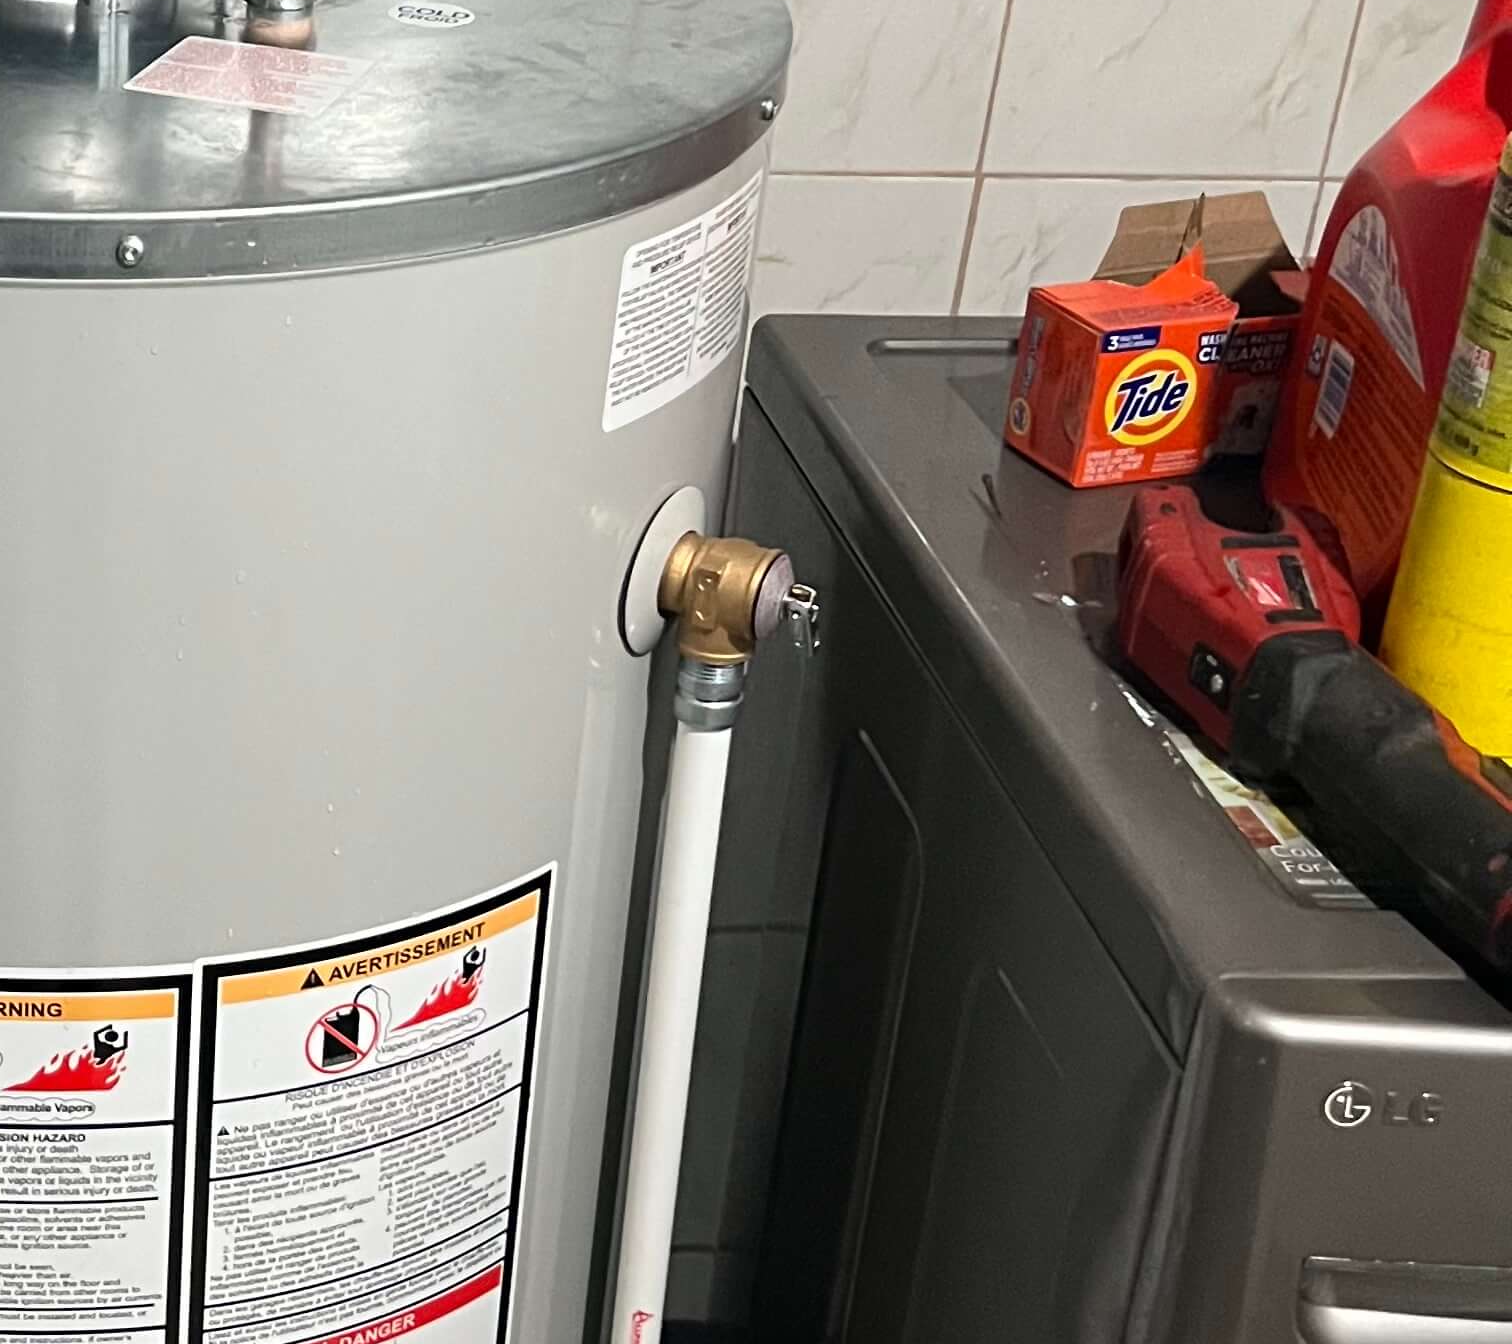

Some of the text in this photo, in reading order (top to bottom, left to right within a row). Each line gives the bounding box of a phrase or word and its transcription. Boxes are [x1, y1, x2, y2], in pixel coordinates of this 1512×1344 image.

[398, 6, 469, 19] COLD
[398, 13, 458, 23] FROID
[1108, 336, 1120, 351] 3
[1111, 371, 1189, 433] Tide
[330, 922, 486, 981] AVERTISSEMENT
[54, 1102, 94, 1115] Vapors
[1383, 1090, 1441, 1125] LG
[33, 1134, 86, 1142] HAZARD
